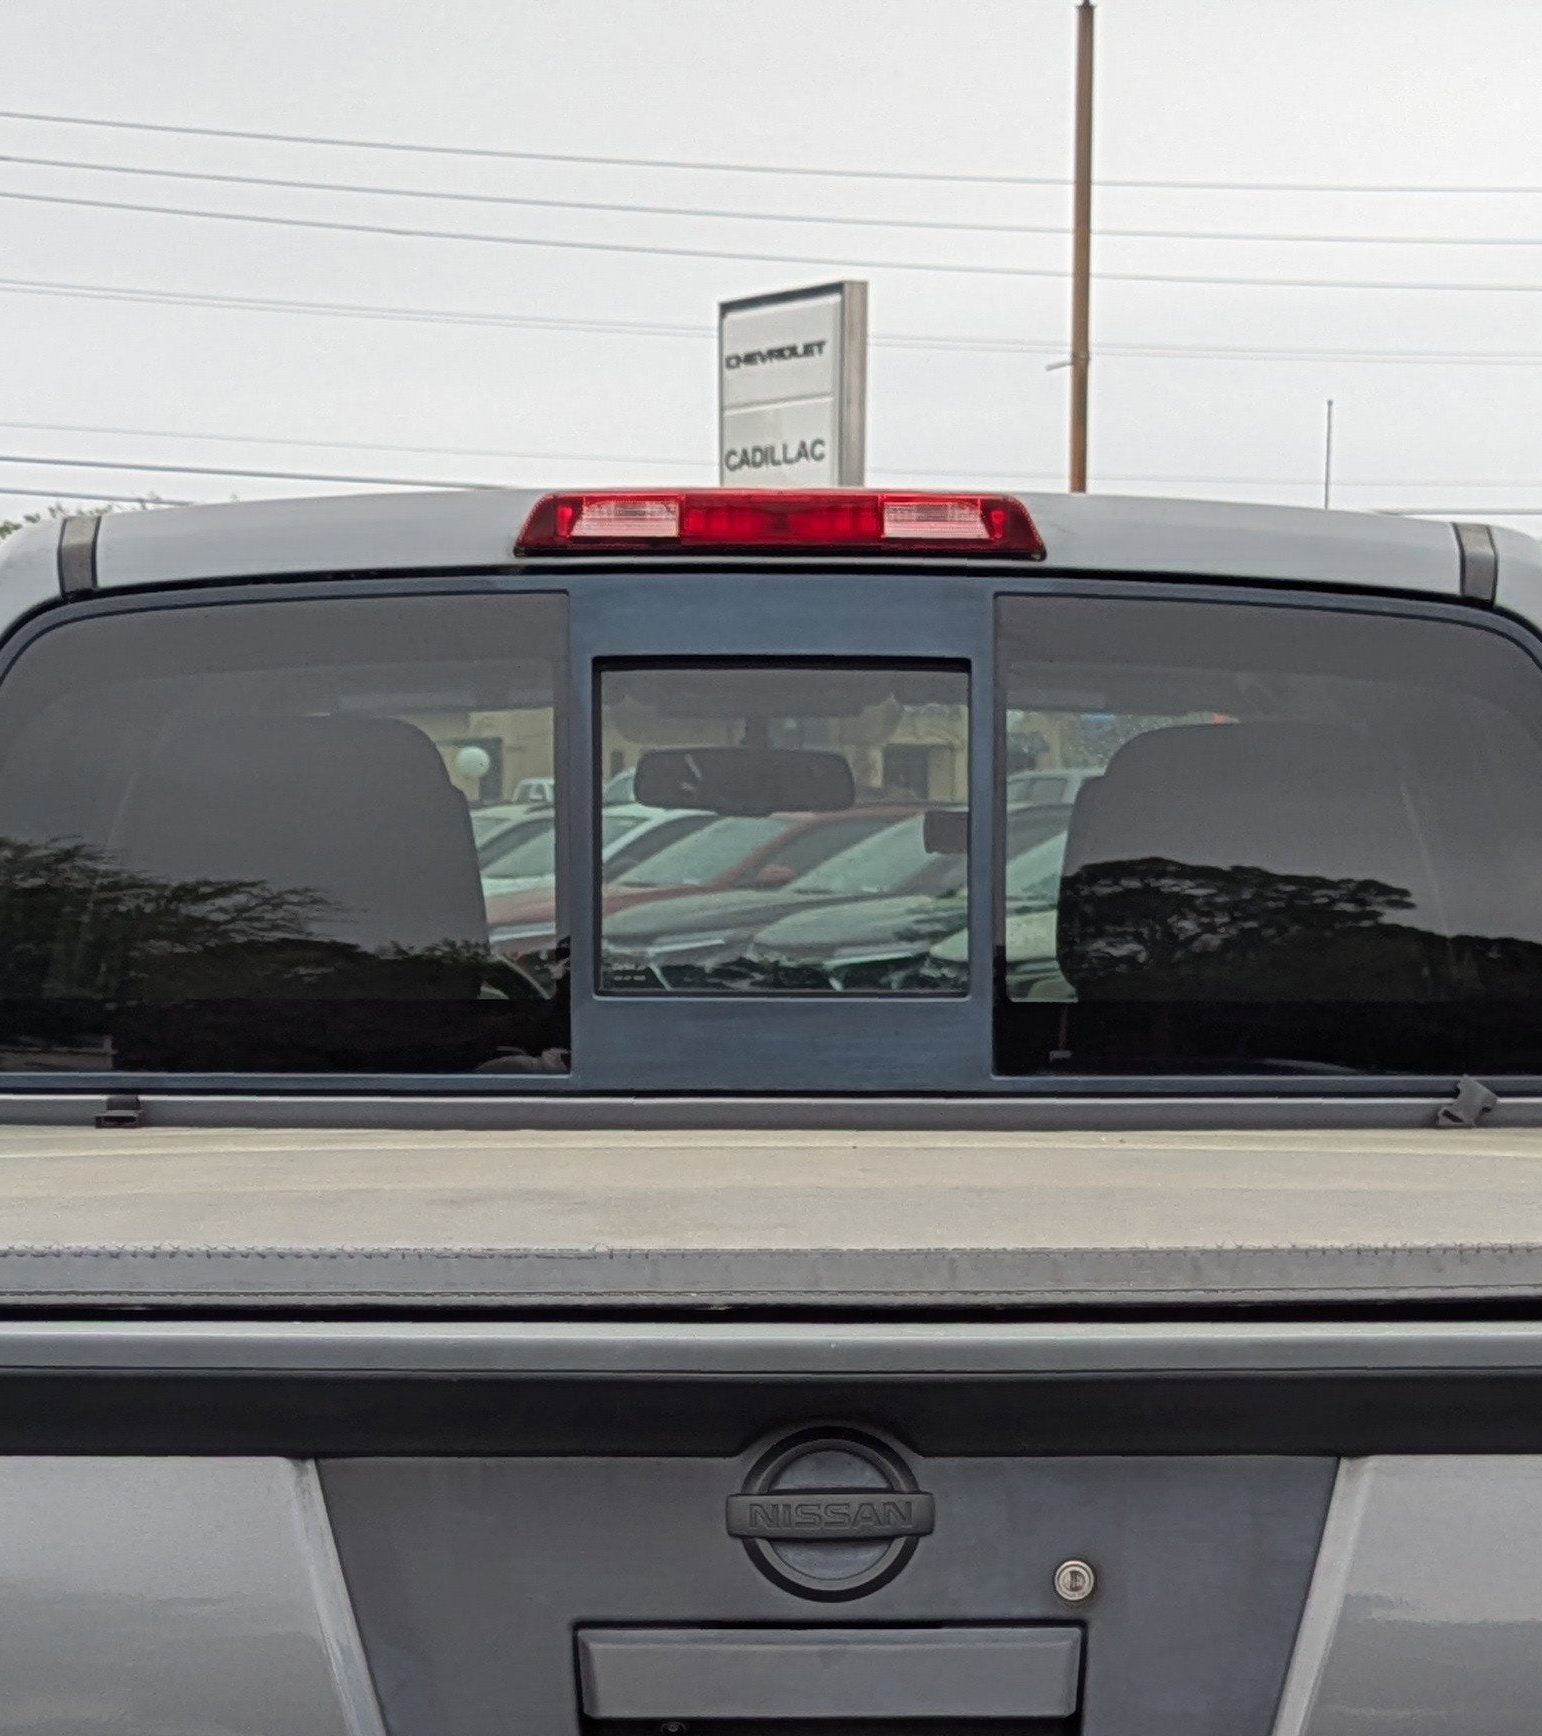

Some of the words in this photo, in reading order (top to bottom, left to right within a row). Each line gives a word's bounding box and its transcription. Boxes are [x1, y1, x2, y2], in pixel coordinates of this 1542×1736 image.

[725, 340, 826, 370] CHEVROLET
[724, 438, 826, 472] CADILLAC
[748, 1500, 914, 1530] NISSAN
